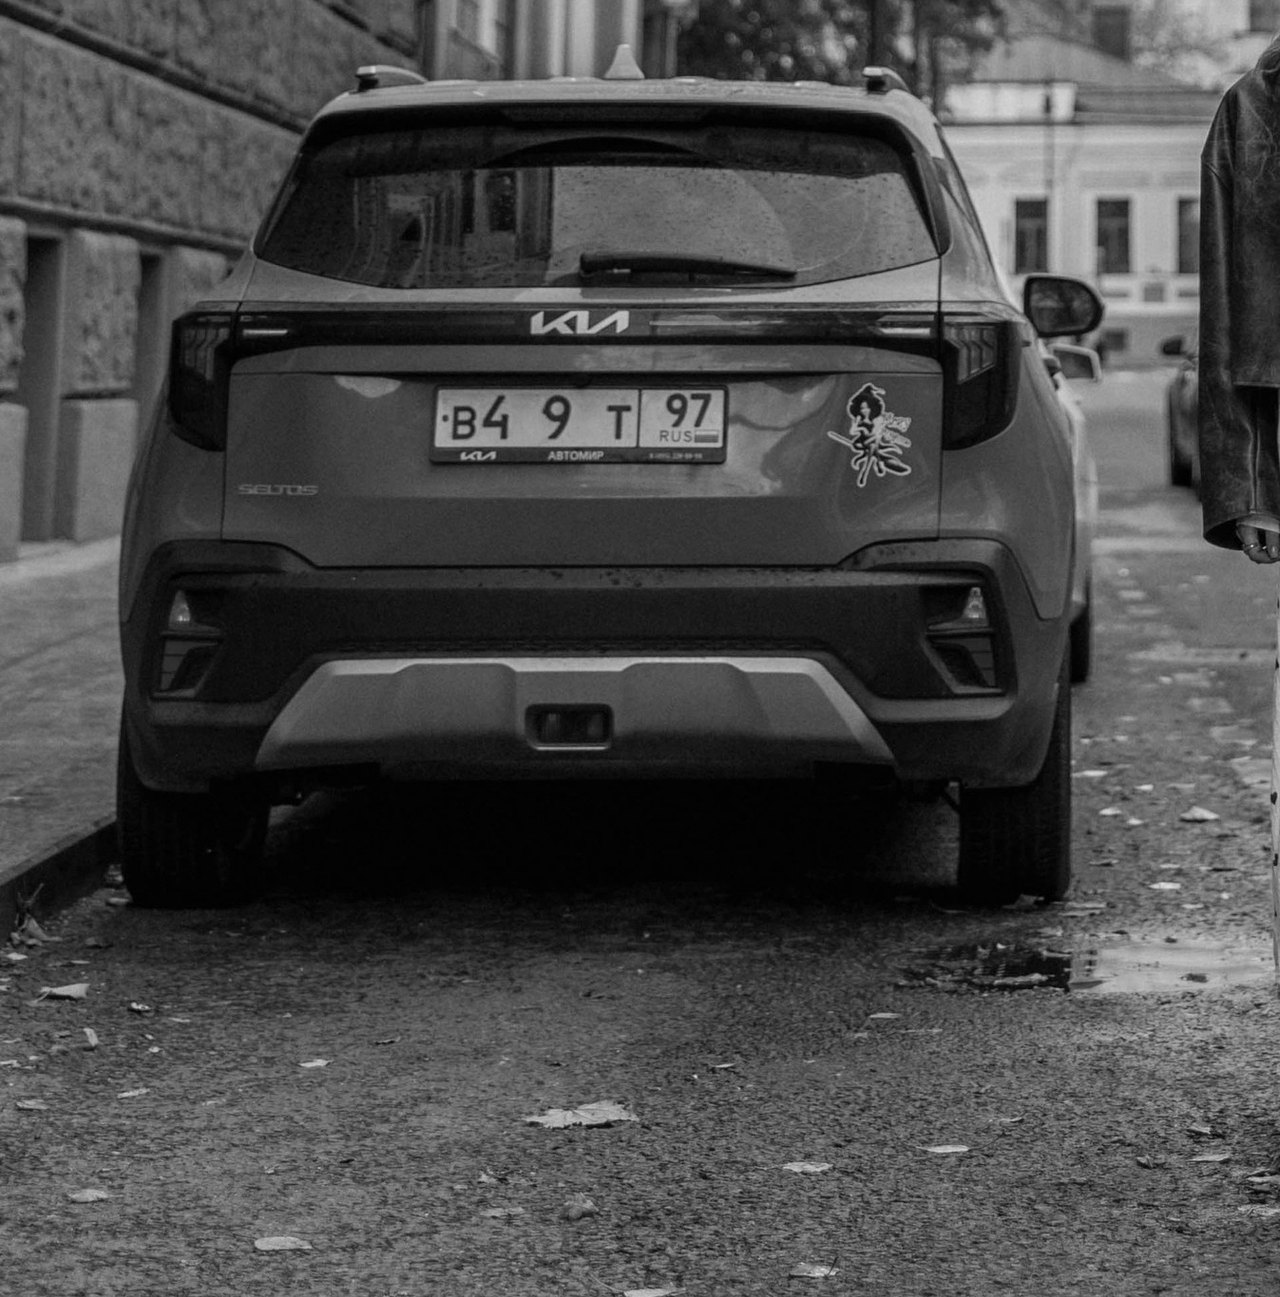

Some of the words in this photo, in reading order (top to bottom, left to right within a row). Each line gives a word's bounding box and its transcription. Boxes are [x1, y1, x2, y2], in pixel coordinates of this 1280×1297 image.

[530, 310, 629, 334] KIA
[666, 393, 712, 428] 97
[660, 430, 692, 443] RUS
[548, 451, 604, 461] АВТОМИР
[238, 484, 318, 496] SELTOS
